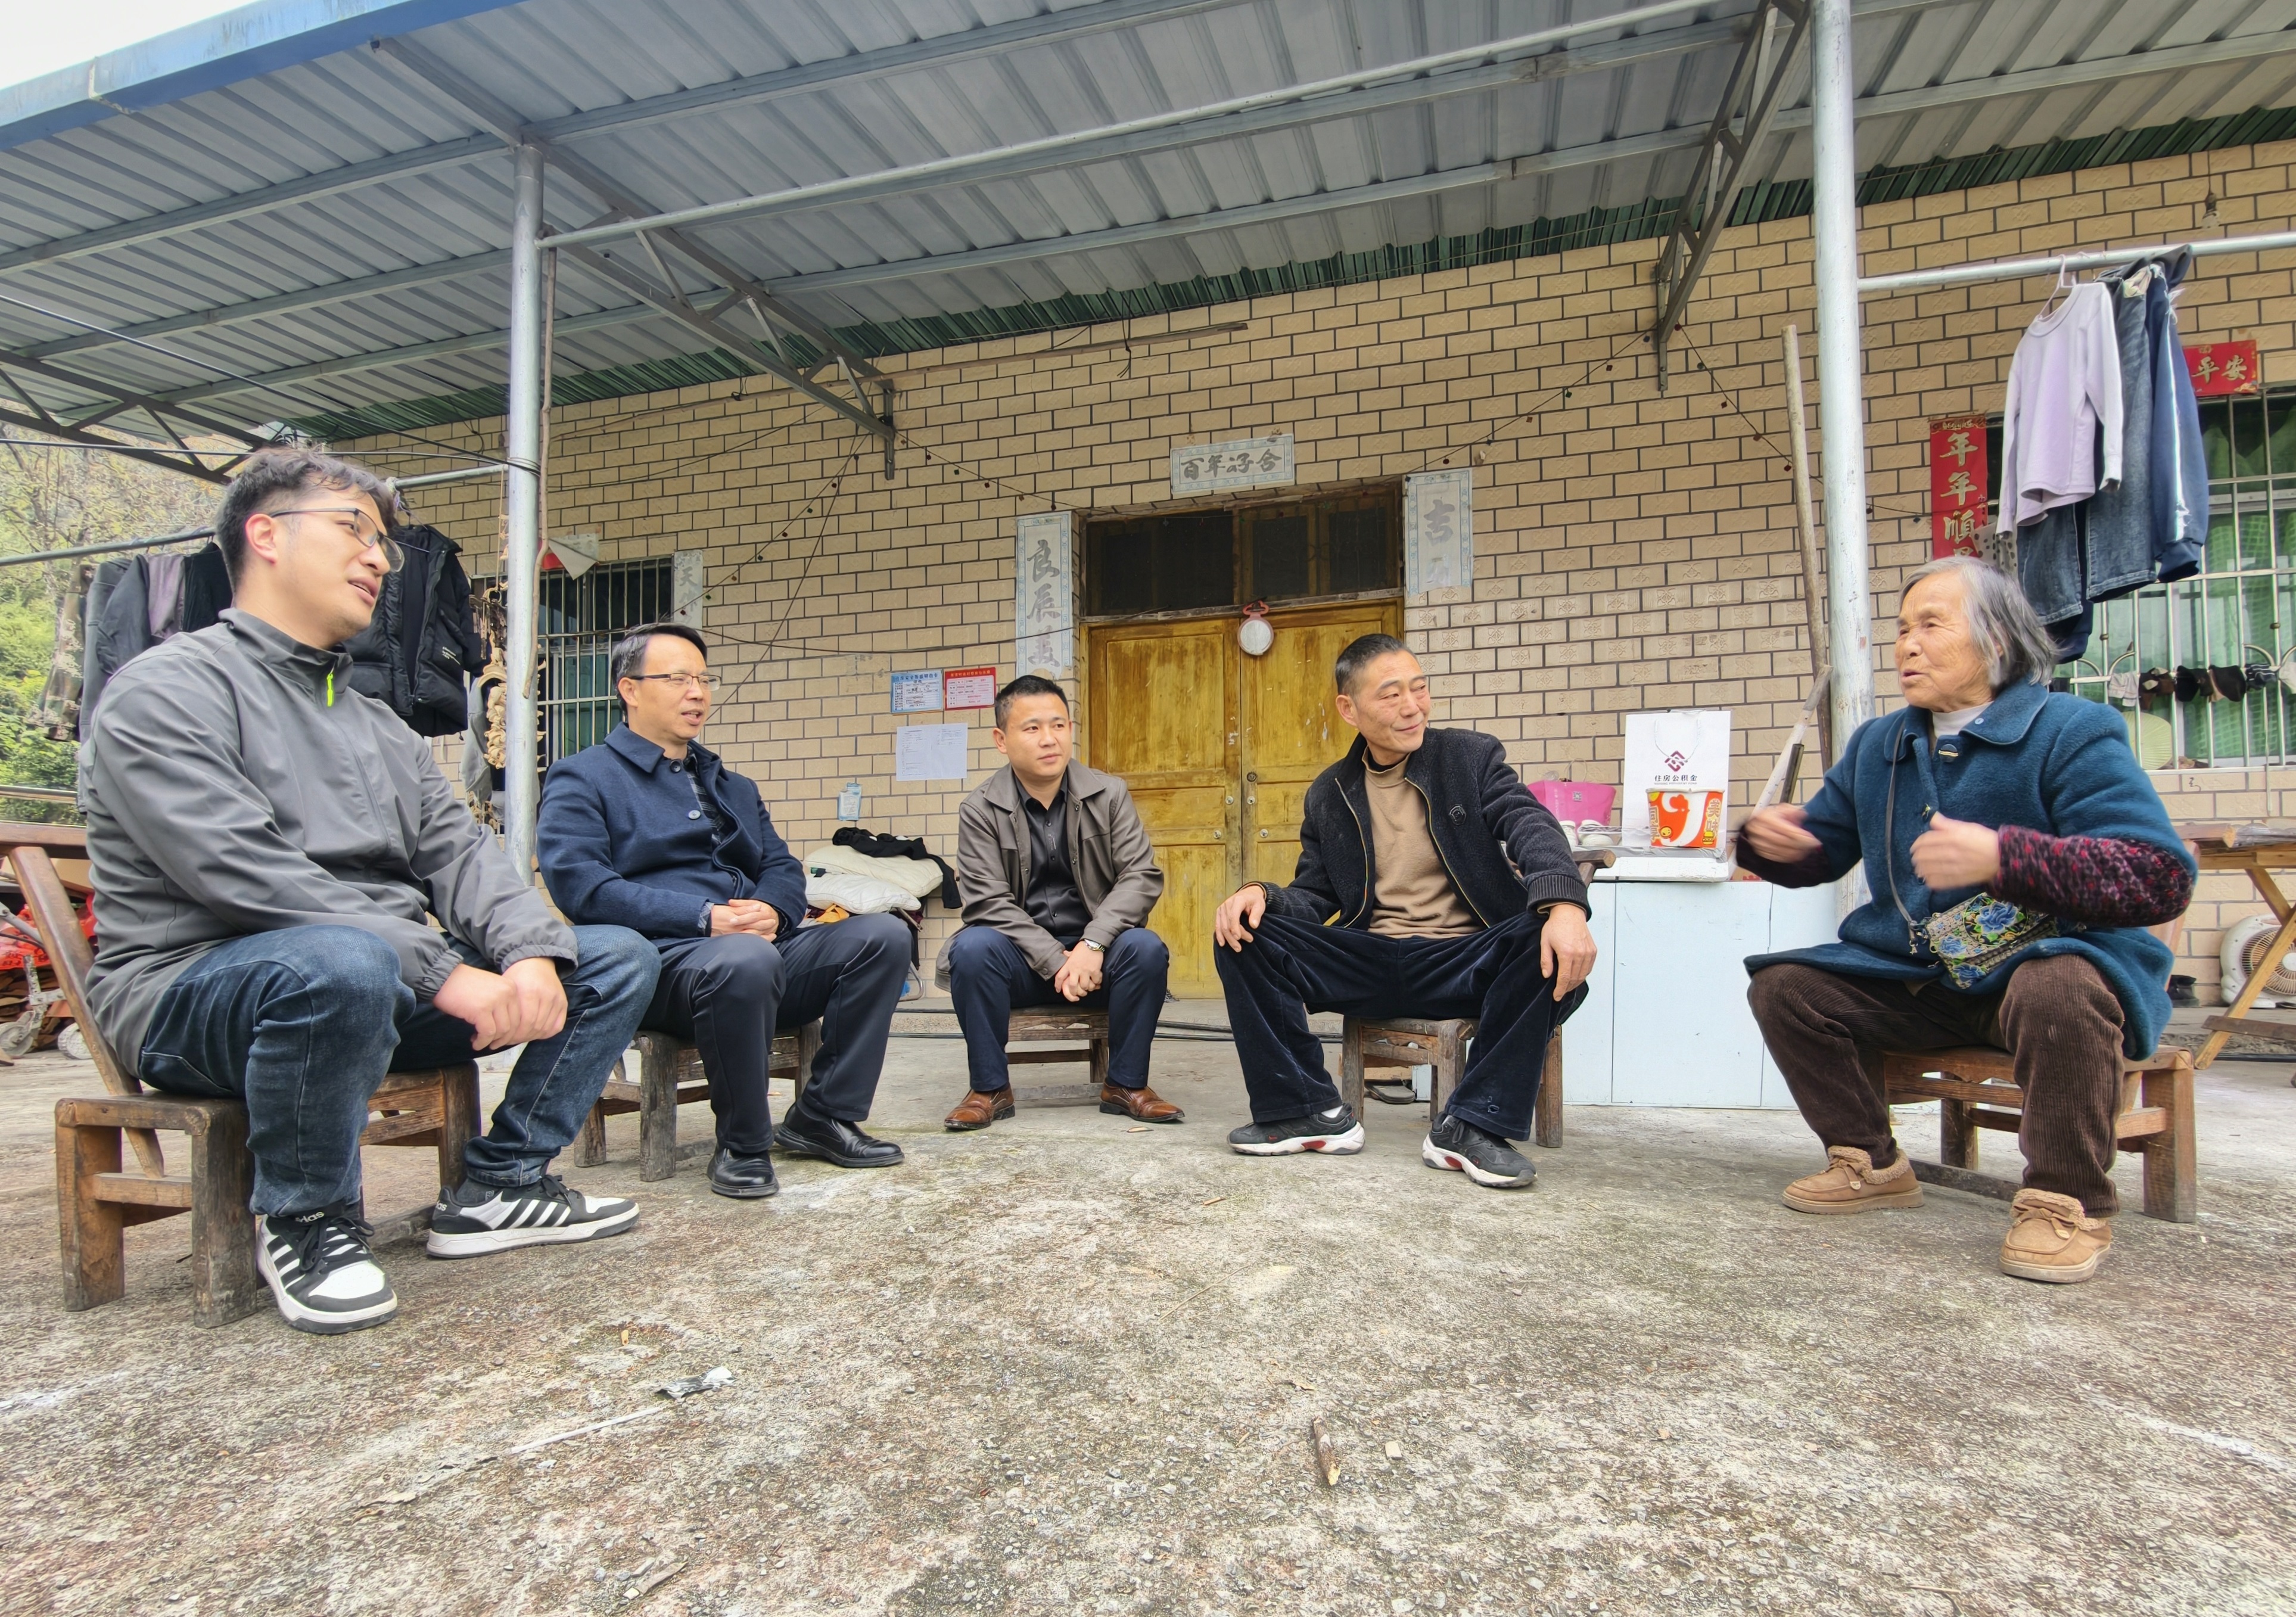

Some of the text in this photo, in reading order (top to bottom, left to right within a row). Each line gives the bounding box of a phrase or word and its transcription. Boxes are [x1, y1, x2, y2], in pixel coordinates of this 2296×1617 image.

[1181, 448, 1282, 480] 百年好合
[1706, 799, 1719, 836] 美味
